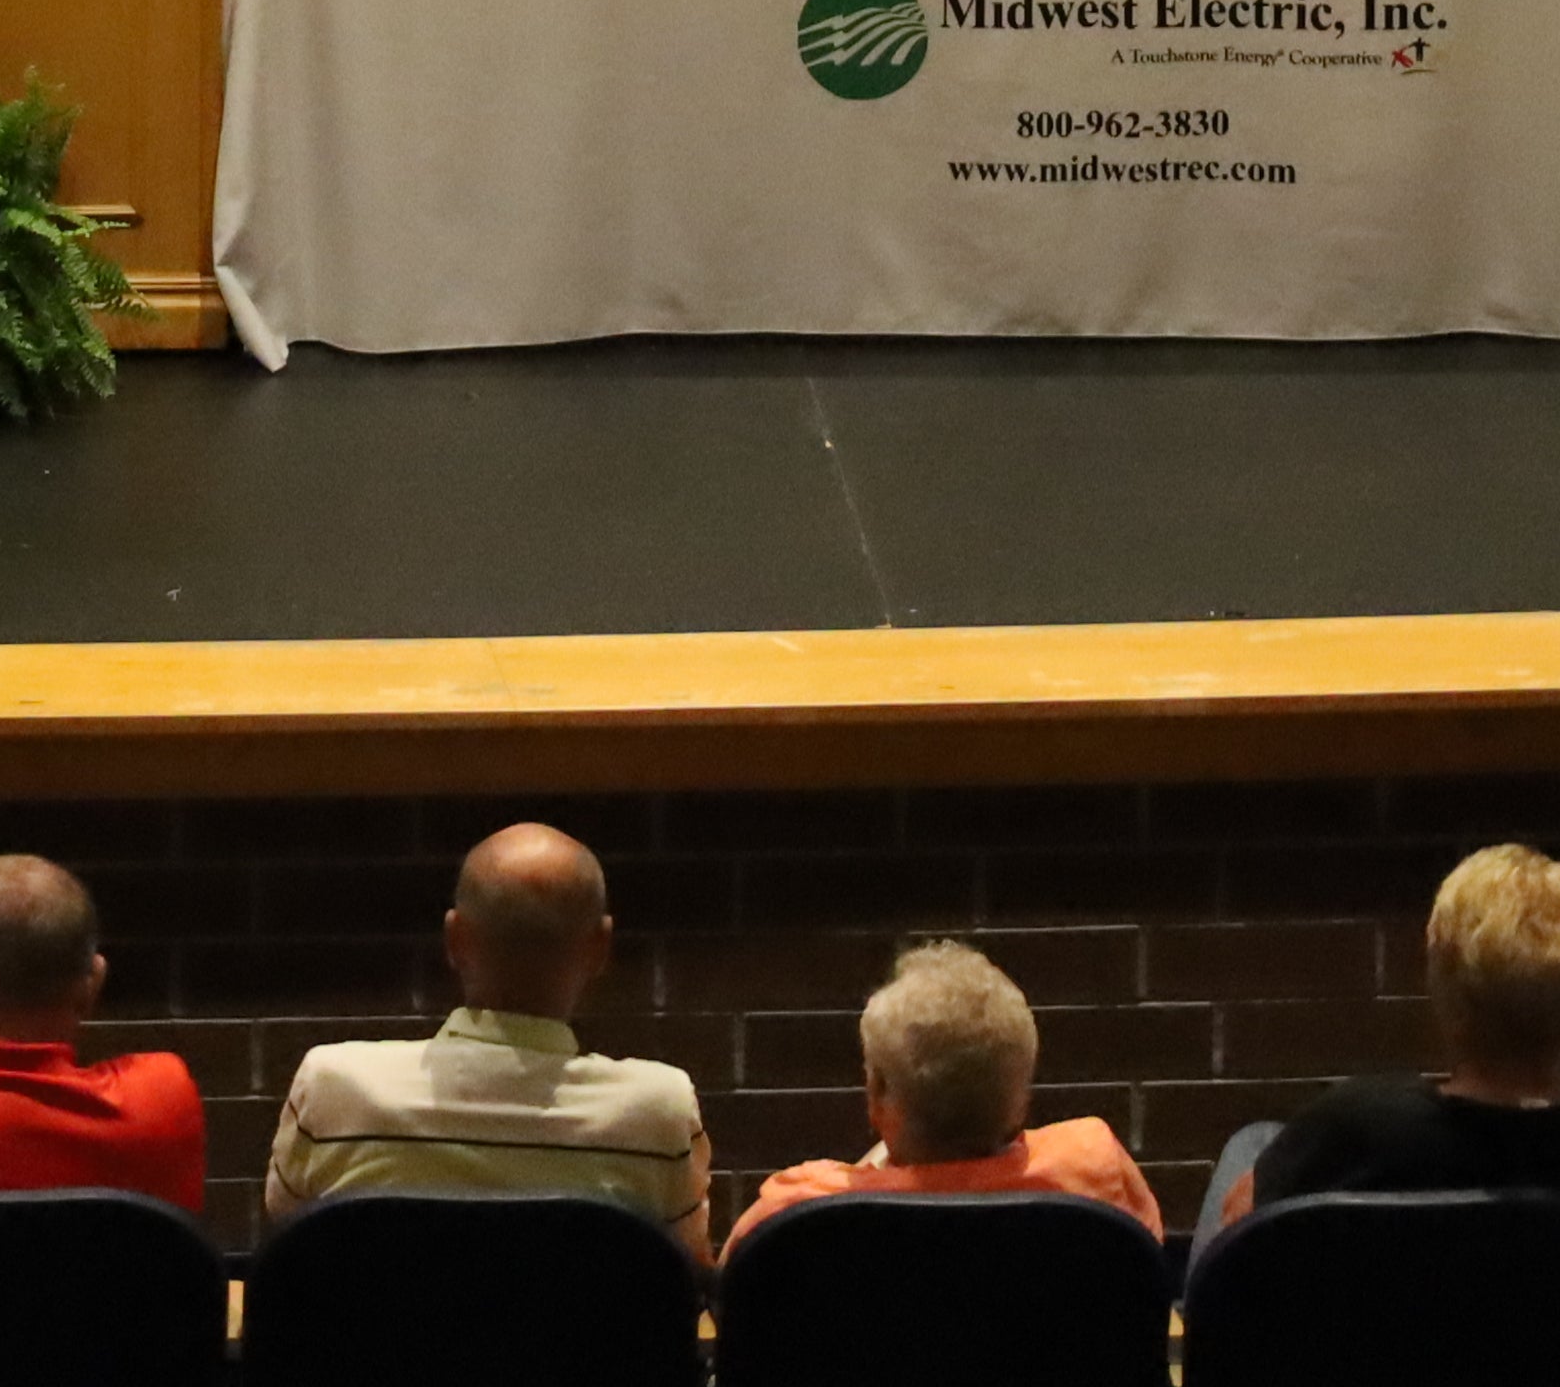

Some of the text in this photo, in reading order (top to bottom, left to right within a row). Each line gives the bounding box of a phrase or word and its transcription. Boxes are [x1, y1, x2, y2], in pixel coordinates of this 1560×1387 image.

[1112, 49, 1125, 65] A
[1132, 47, 1218, 64] Touchstone
[1288, 50, 1383, 69] Cooperative
[1016, 109, 1229, 139] 800-962-3830
[948, 154, 1296, 184] www.midwestrec.com
